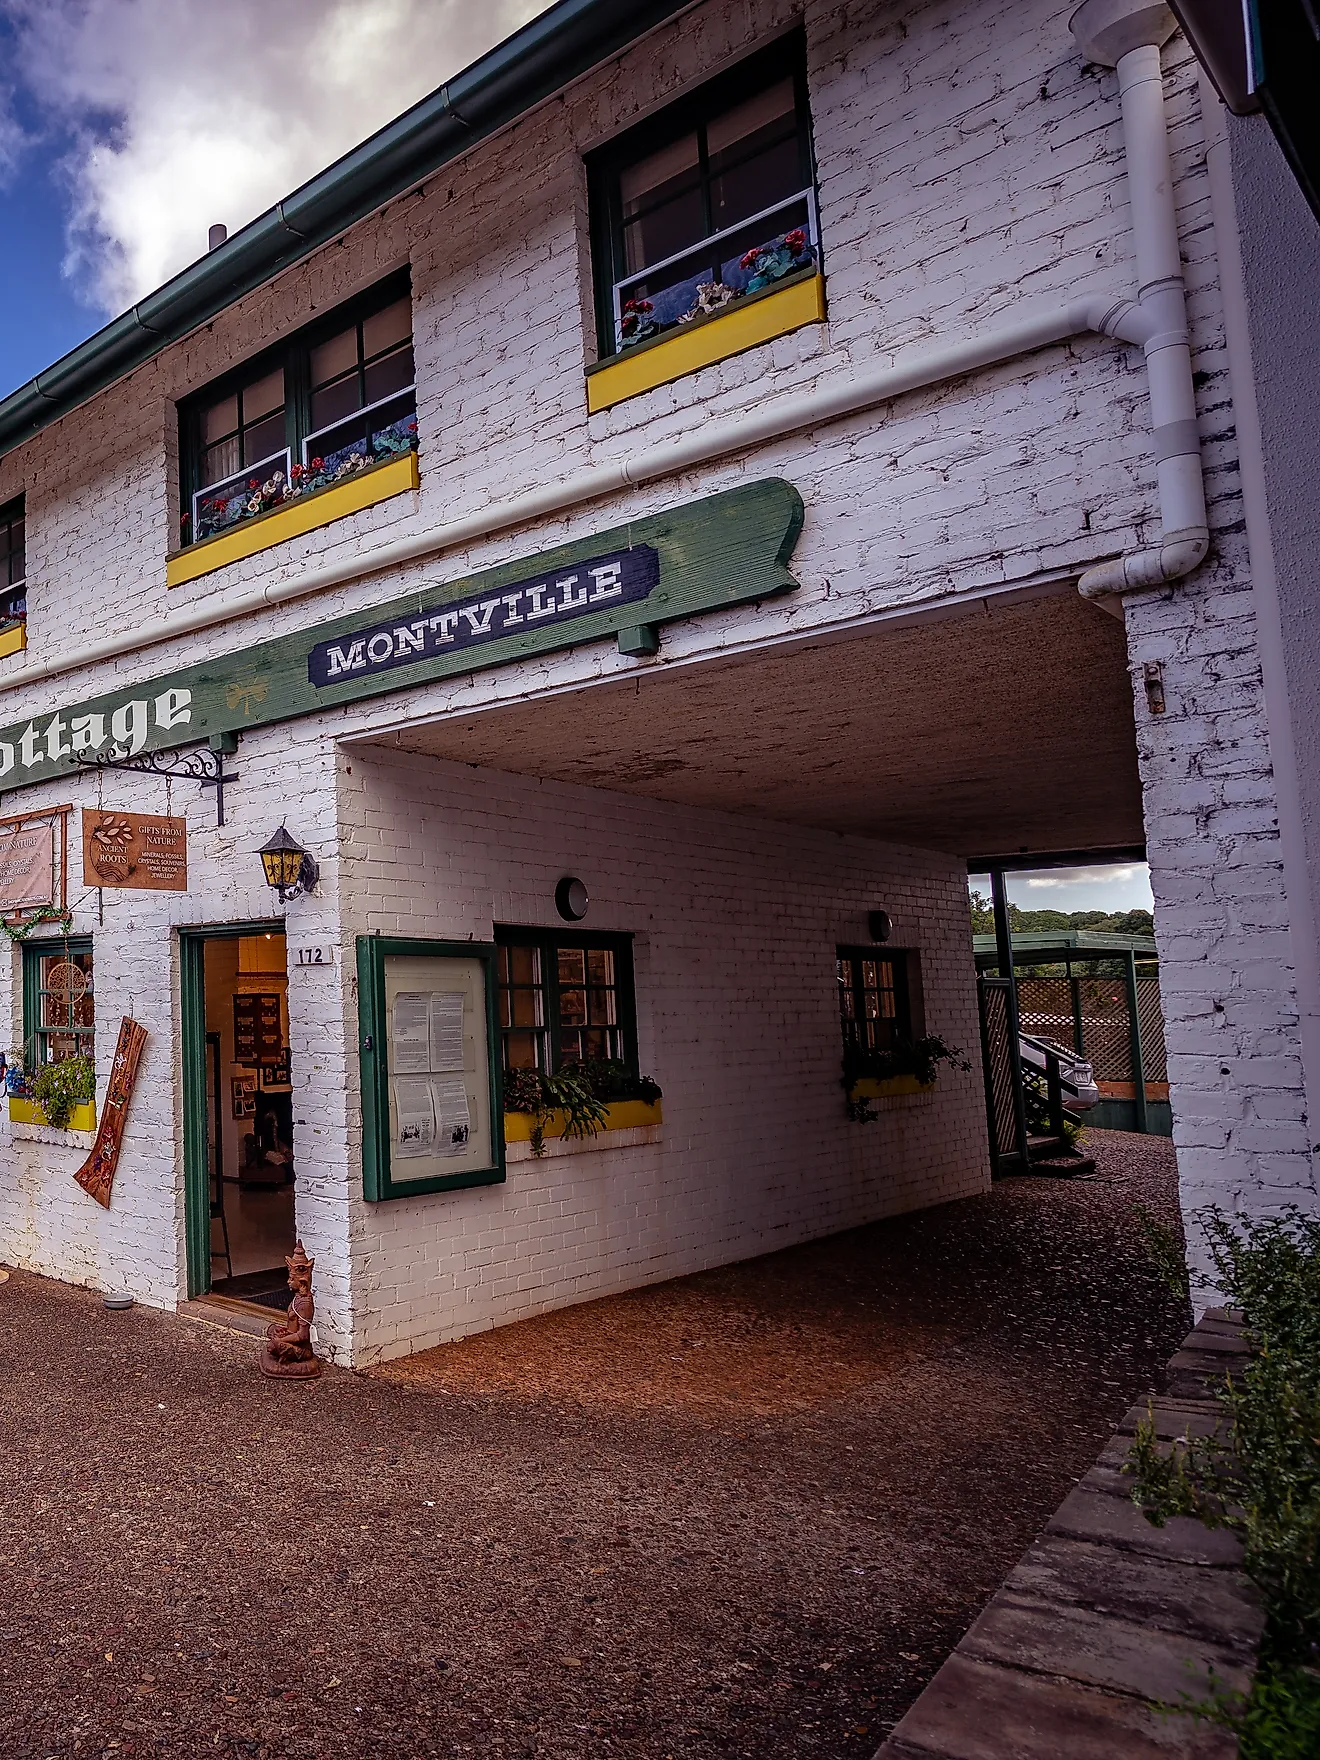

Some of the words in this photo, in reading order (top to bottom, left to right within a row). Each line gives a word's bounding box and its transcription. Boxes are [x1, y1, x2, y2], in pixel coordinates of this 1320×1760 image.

[326, 561, 622, 677] MONTVILLE
[138, 825, 160, 835] GIFTS
[161, 827, 182, 837] FROM
[9, 837, 38, 852] NATURE
[146, 836, 177, 846] NATURE
[97, 844, 128, 853] ANCIENT
[100, 854, 128, 863] ROOTS
[298, 948, 323, 964] 172
